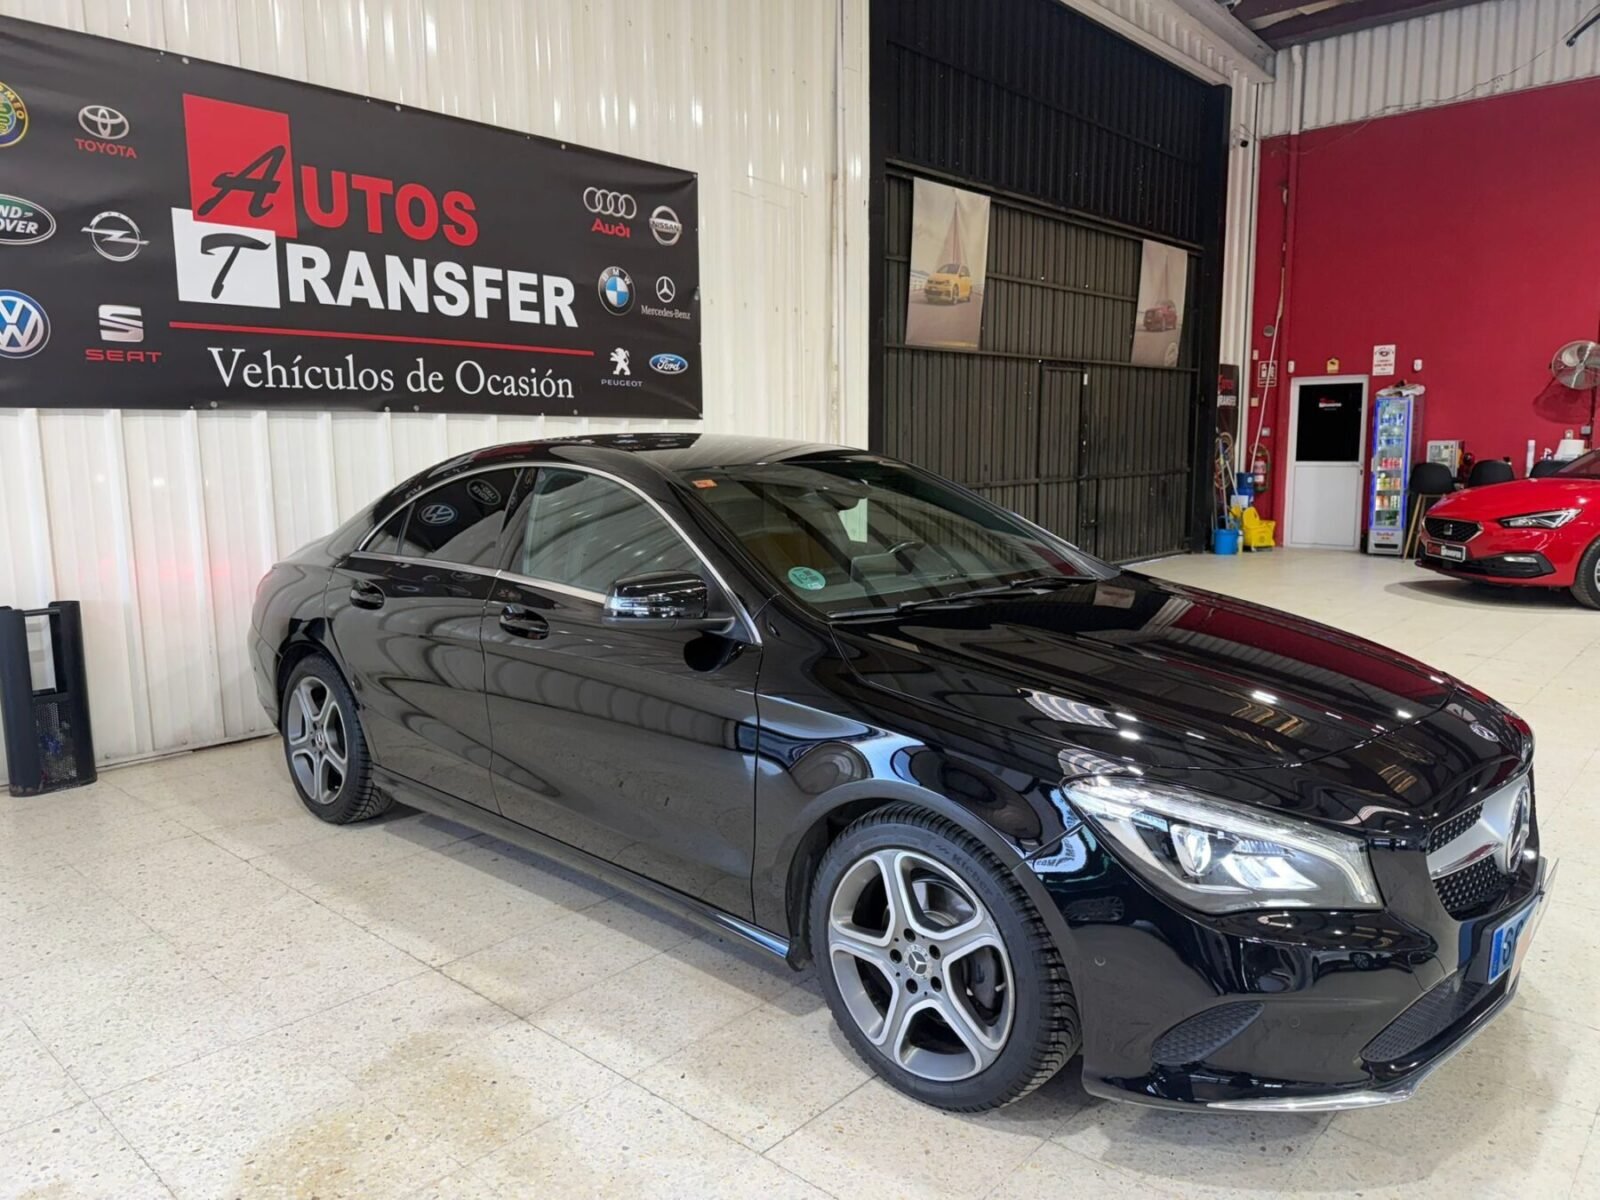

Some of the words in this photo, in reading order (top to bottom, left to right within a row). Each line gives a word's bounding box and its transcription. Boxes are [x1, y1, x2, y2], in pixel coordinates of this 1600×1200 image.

[75, 138, 137, 159] TOYOTA
[591, 218, 631, 238] Audi
[651, 221, 680, 232] NISSAN
[200, 232, 579, 328] TRANSFER
[640, 304, 691, 320] Mercedes-Benz
[85, 348, 162, 364] SEAT
[207, 346, 395, 392] Vehículos
[406, 357, 445, 394] de
[455, 359, 575, 399] Ocasión
[655, 357, 682, 372] Ford
[600, 378, 643, 388] PEUGEOT
